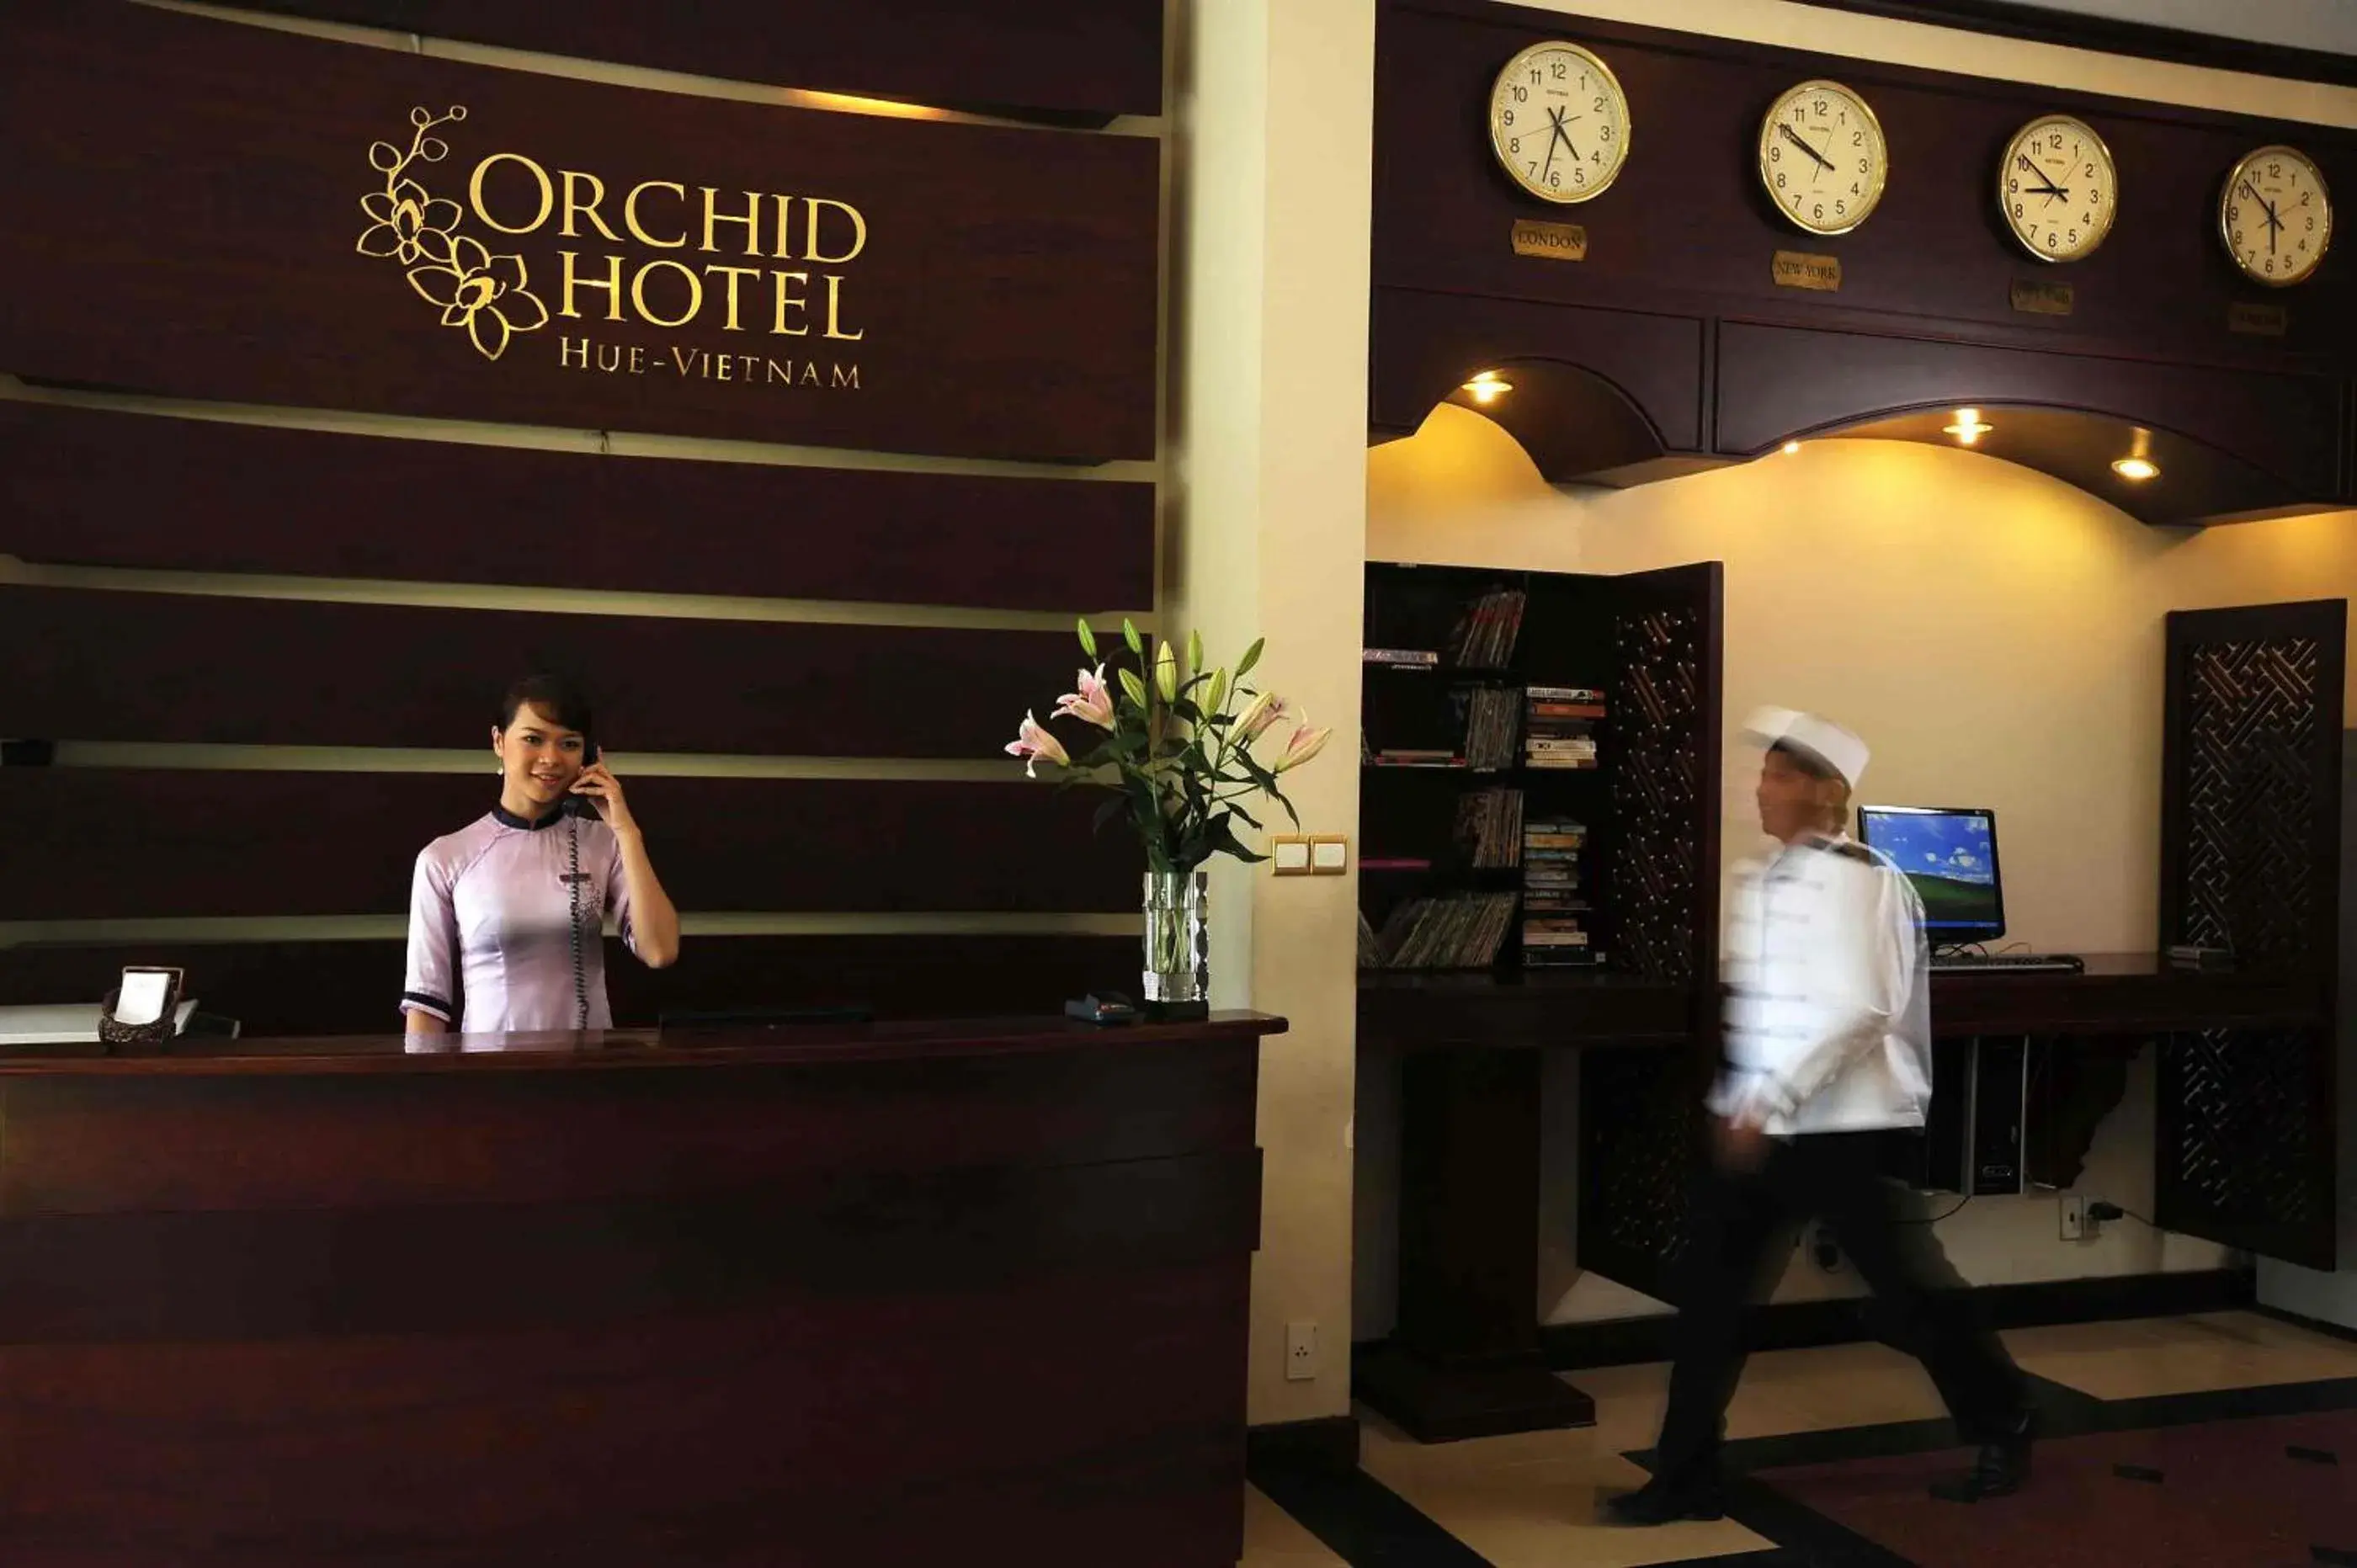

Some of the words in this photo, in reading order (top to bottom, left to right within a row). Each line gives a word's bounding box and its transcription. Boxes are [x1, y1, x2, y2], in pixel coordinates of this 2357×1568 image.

[1530, 70, 1541, 84] 11
[1551, 63, 1566, 79] 12
[1580, 76, 1585, 90] 1
[1513, 87, 1528, 102] 10
[1594, 98, 1603, 112] 2
[1814, 101, 1828, 116] 12
[1504, 110, 1514, 125] 9
[1796, 109, 1804, 123] 11
[1839, 112, 1845, 125] 1
[1601, 126, 1609, 141] 3
[1853, 132, 1861, 146] 2
[1510, 138, 1519, 153] 8
[2032, 141, 2041, 155] 11
[2050, 135, 2062, 149] 12
[1592, 151, 1600, 165] 4
[1772, 147, 1780, 162] 9
[2074, 145, 2078, 157] 1
[1529, 162, 1538, 177] 7
[1860, 159, 1868, 173] 3
[2086, 164, 2094, 178] 2
[2269, 165, 2280, 178] 12
[1551, 172, 1560, 187] 6
[1575, 168, 1584, 183] 5
[1777, 173, 1785, 188] 8
[2252, 171, 2260, 183] 11
[2290, 174, 2296, 187] 1
[1851, 183, 1859, 196] 4
[2010, 179, 2018, 193] 9
[2238, 186, 2248, 199] 10
[1794, 195, 1802, 210] 7
[2091, 189, 2099, 203] 3
[2301, 192, 2309, 205] 2
[469, 153, 867, 263] ORCHID
[1814, 205, 1822, 218] 6
[1836, 200, 1844, 214] 5
[2015, 204, 2023, 218] 8
[2231, 207, 2237, 220] 9
[2083, 212, 2089, 225] 4
[2306, 217, 2313, 231] 3
[2030, 225, 2037, 238] 7
[2069, 229, 2076, 242] 5
[2235, 231, 2243, 244] 8
[1518, 231, 1582, 249] LONDON
[2049, 233, 2056, 247] 6
[2299, 239, 2305, 251] 4
[2248, 251, 2255, 263] 7
[2285, 256, 2292, 268] 5
[1777, 261, 1803, 276] NEW
[1805, 263, 1837, 280] YORK
[2265, 259, 2273, 273] 6
[556, 251, 864, 341] HOTEL
